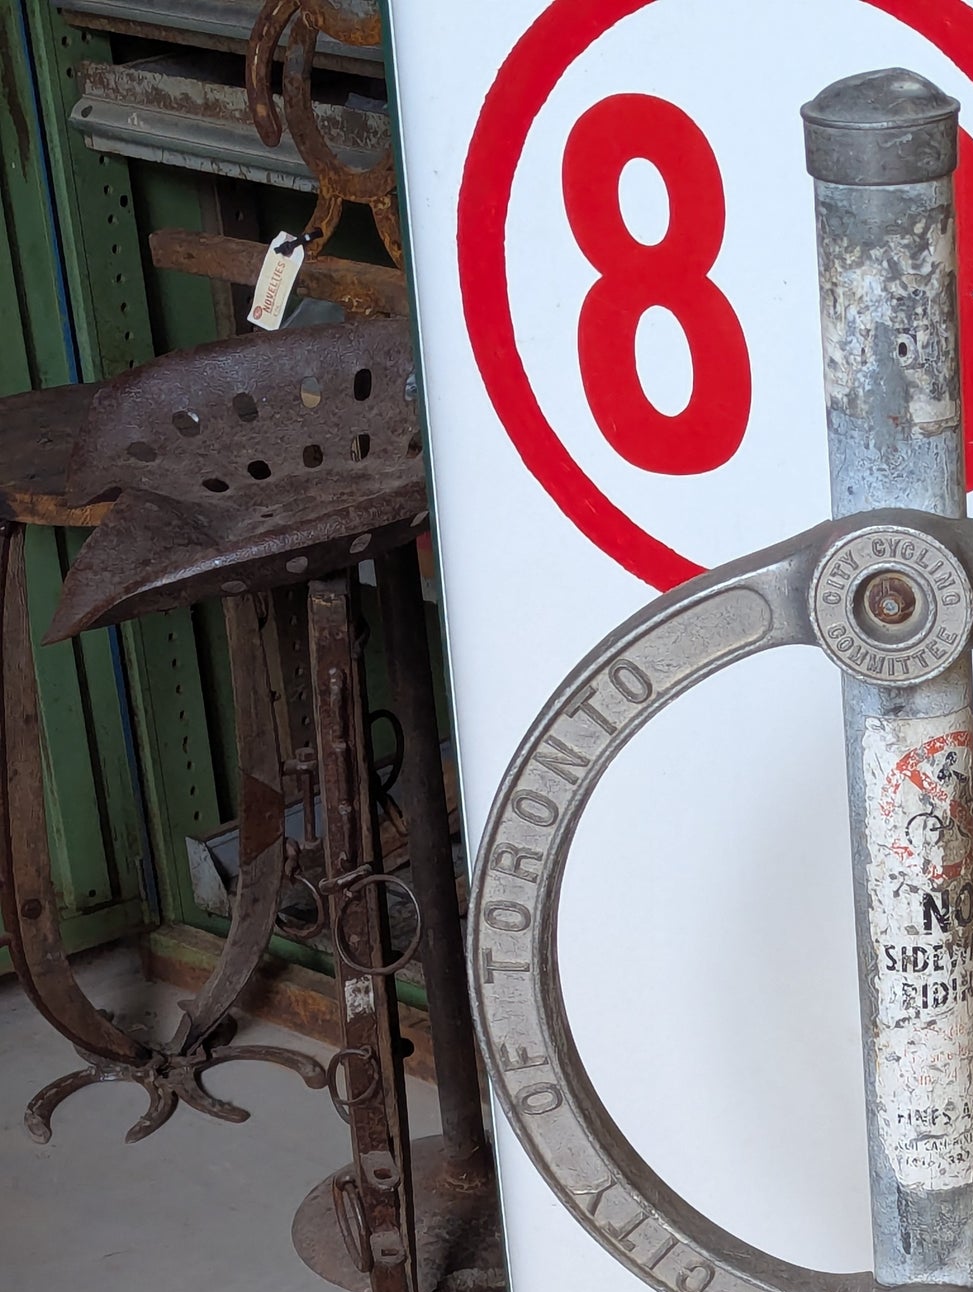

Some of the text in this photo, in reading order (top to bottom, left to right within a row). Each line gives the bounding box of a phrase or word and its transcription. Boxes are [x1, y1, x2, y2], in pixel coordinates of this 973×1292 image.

[262, 261, 286, 314] NOVELTIES
[823, 538, 961, 606] CITY CYCLING
[828, 623, 958, 676] COMMITTEE
[483, 658, 653, 985] TORONTO
[922, 882, 973, 933] NO
[500, 1043, 563, 1116] OF
